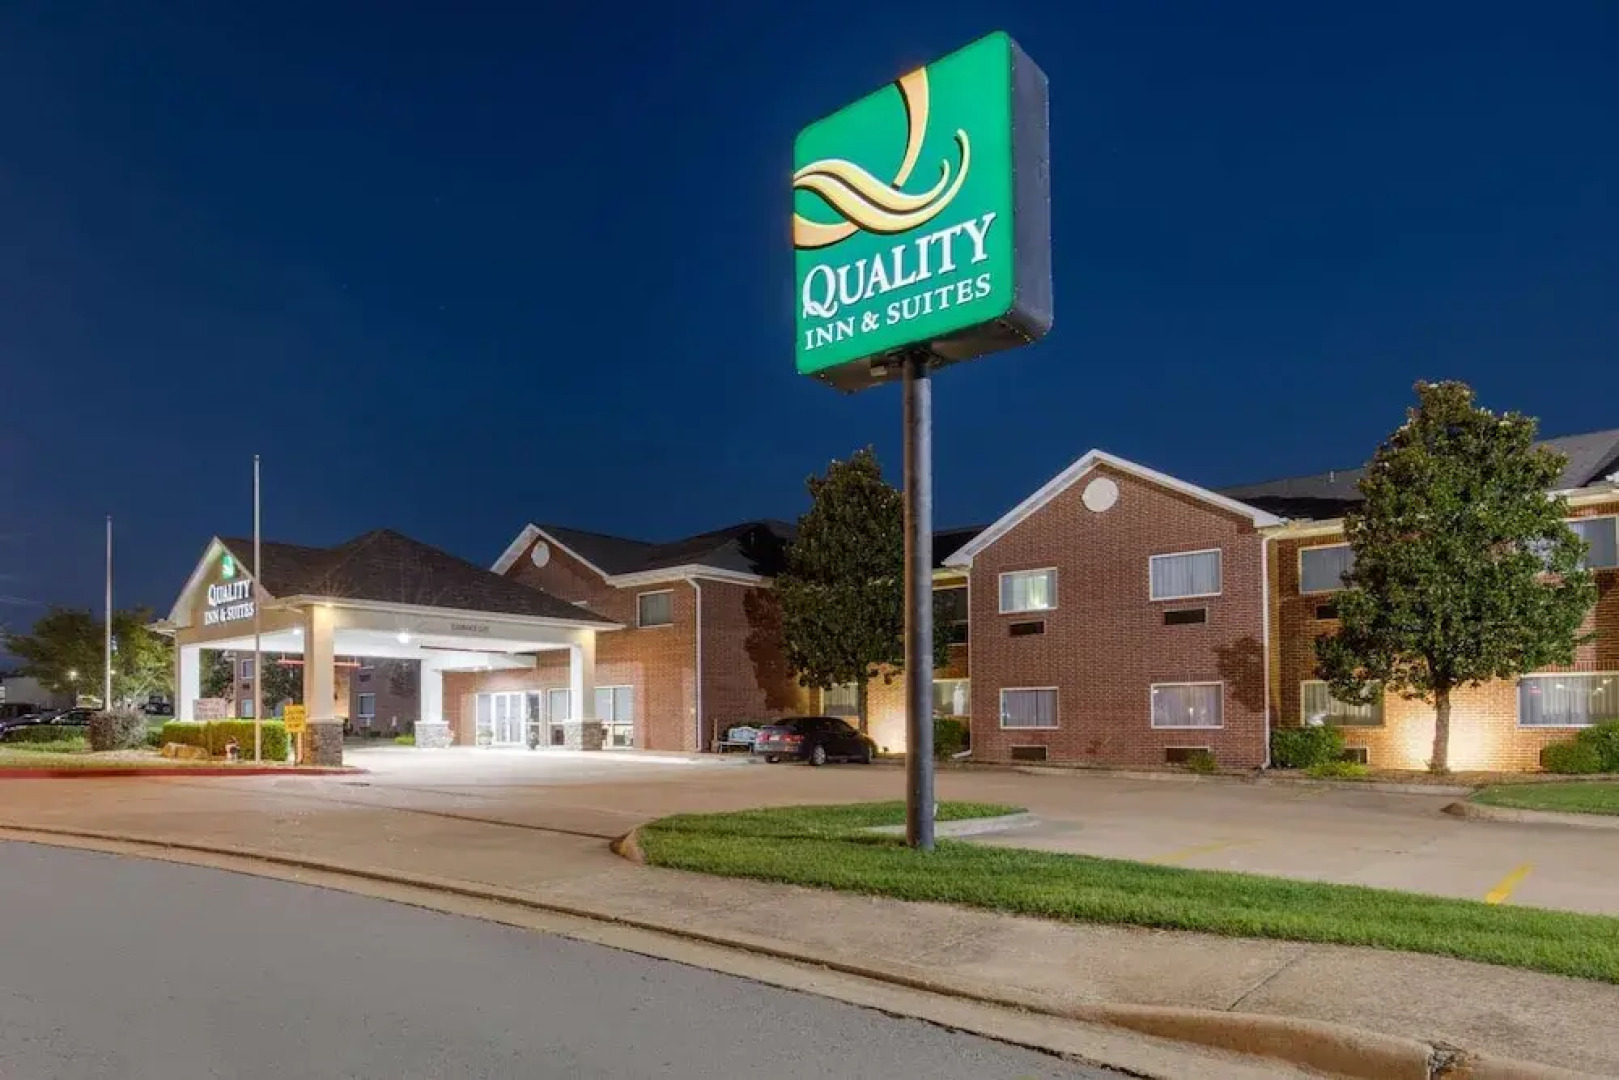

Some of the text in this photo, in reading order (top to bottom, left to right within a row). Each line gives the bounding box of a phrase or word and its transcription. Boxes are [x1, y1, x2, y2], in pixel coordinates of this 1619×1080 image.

[802, 212, 996, 319] QUALITY
[804, 273, 991, 350] INN & SUITES
[207, 580, 252, 607] QUALITY
